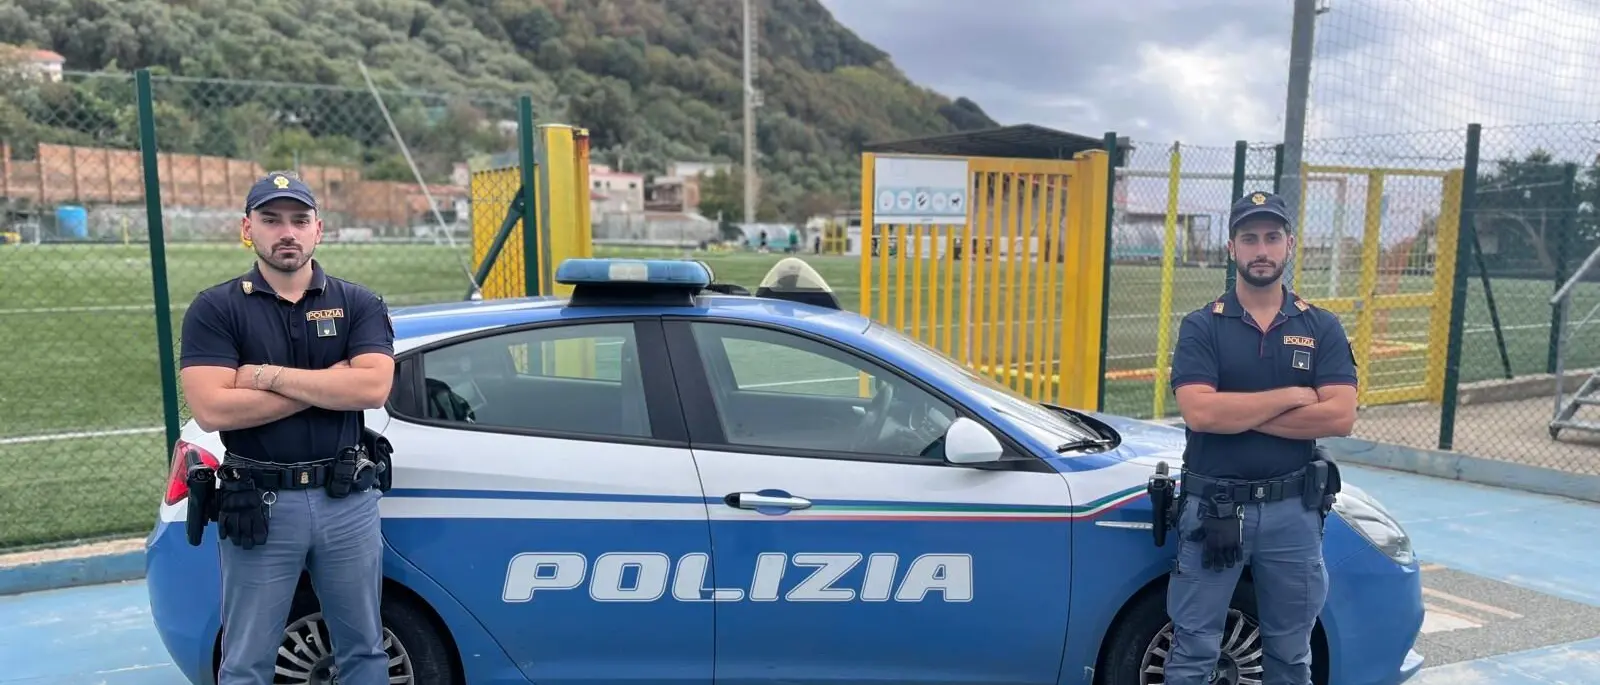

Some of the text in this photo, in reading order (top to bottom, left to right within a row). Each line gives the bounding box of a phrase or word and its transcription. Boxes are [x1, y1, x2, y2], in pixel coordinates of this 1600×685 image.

[308, 310, 342, 319] POLIZIA
[1285, 337, 1315, 347] POLIZIA
[502, 552, 973, 602] POLIZIA
